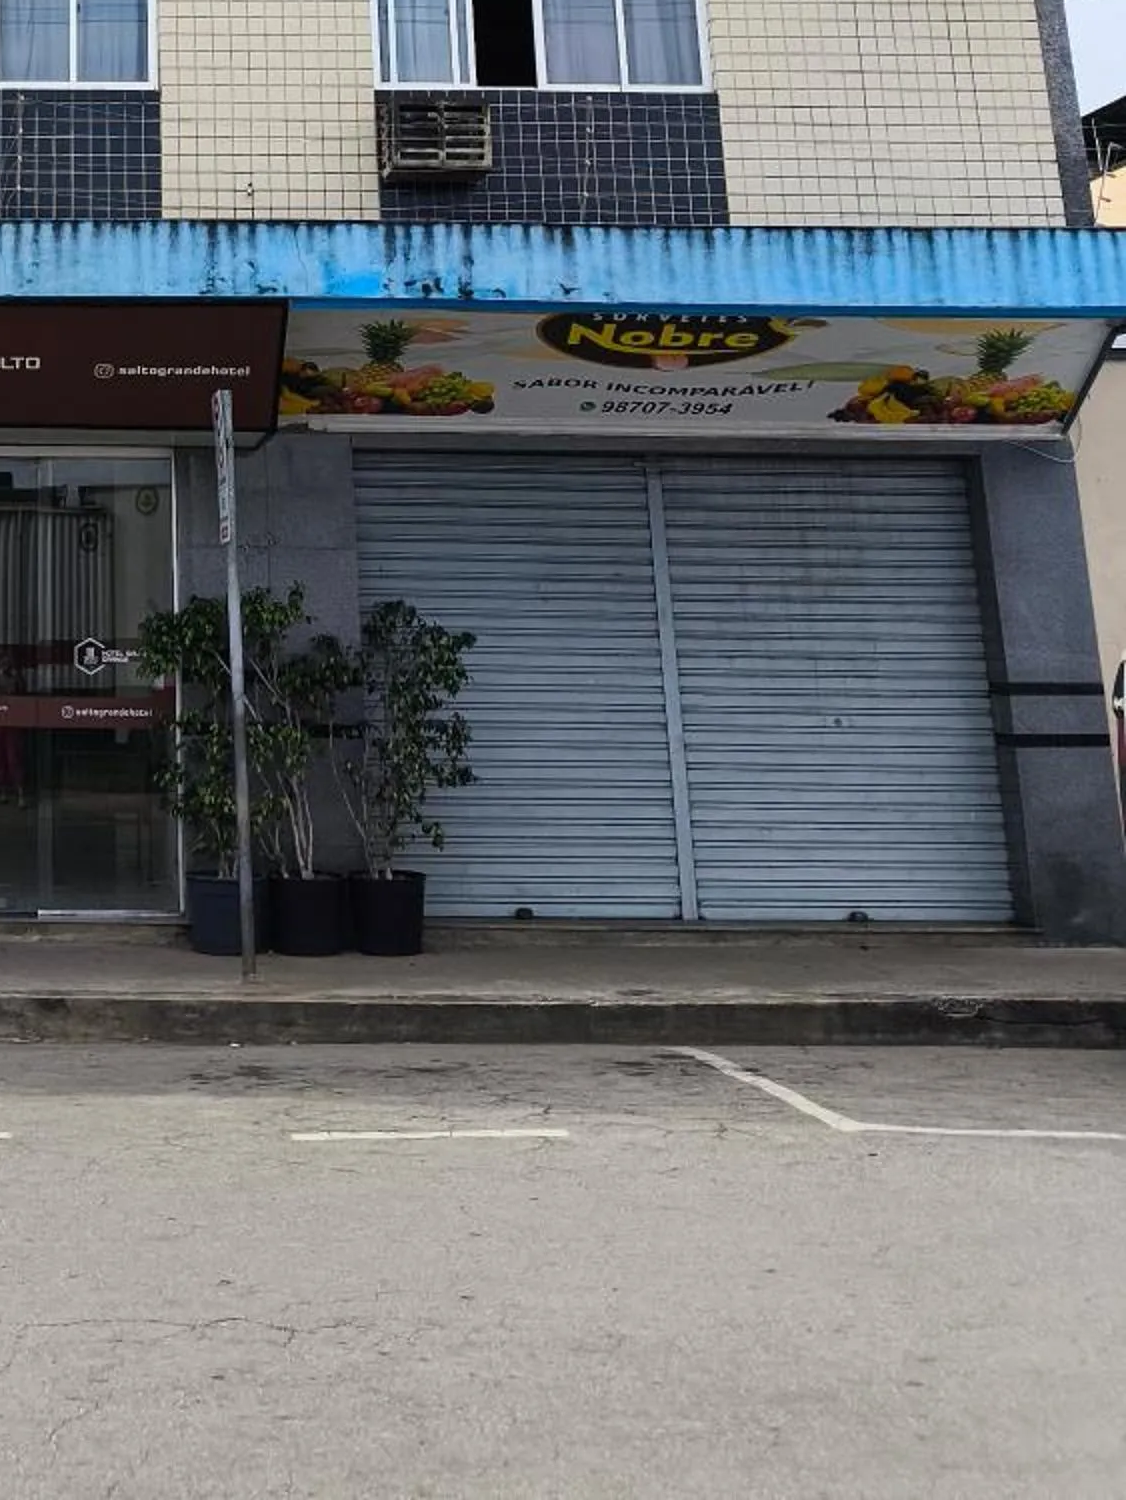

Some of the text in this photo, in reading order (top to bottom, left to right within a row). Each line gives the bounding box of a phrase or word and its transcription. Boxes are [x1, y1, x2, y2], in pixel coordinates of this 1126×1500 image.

[567, 322, 760, 351] Nobre
[118, 365, 252, 377] saltograndehotel
[512, 379, 598, 390] SABOR
[601, 401, 734, 415] 98707-3954
